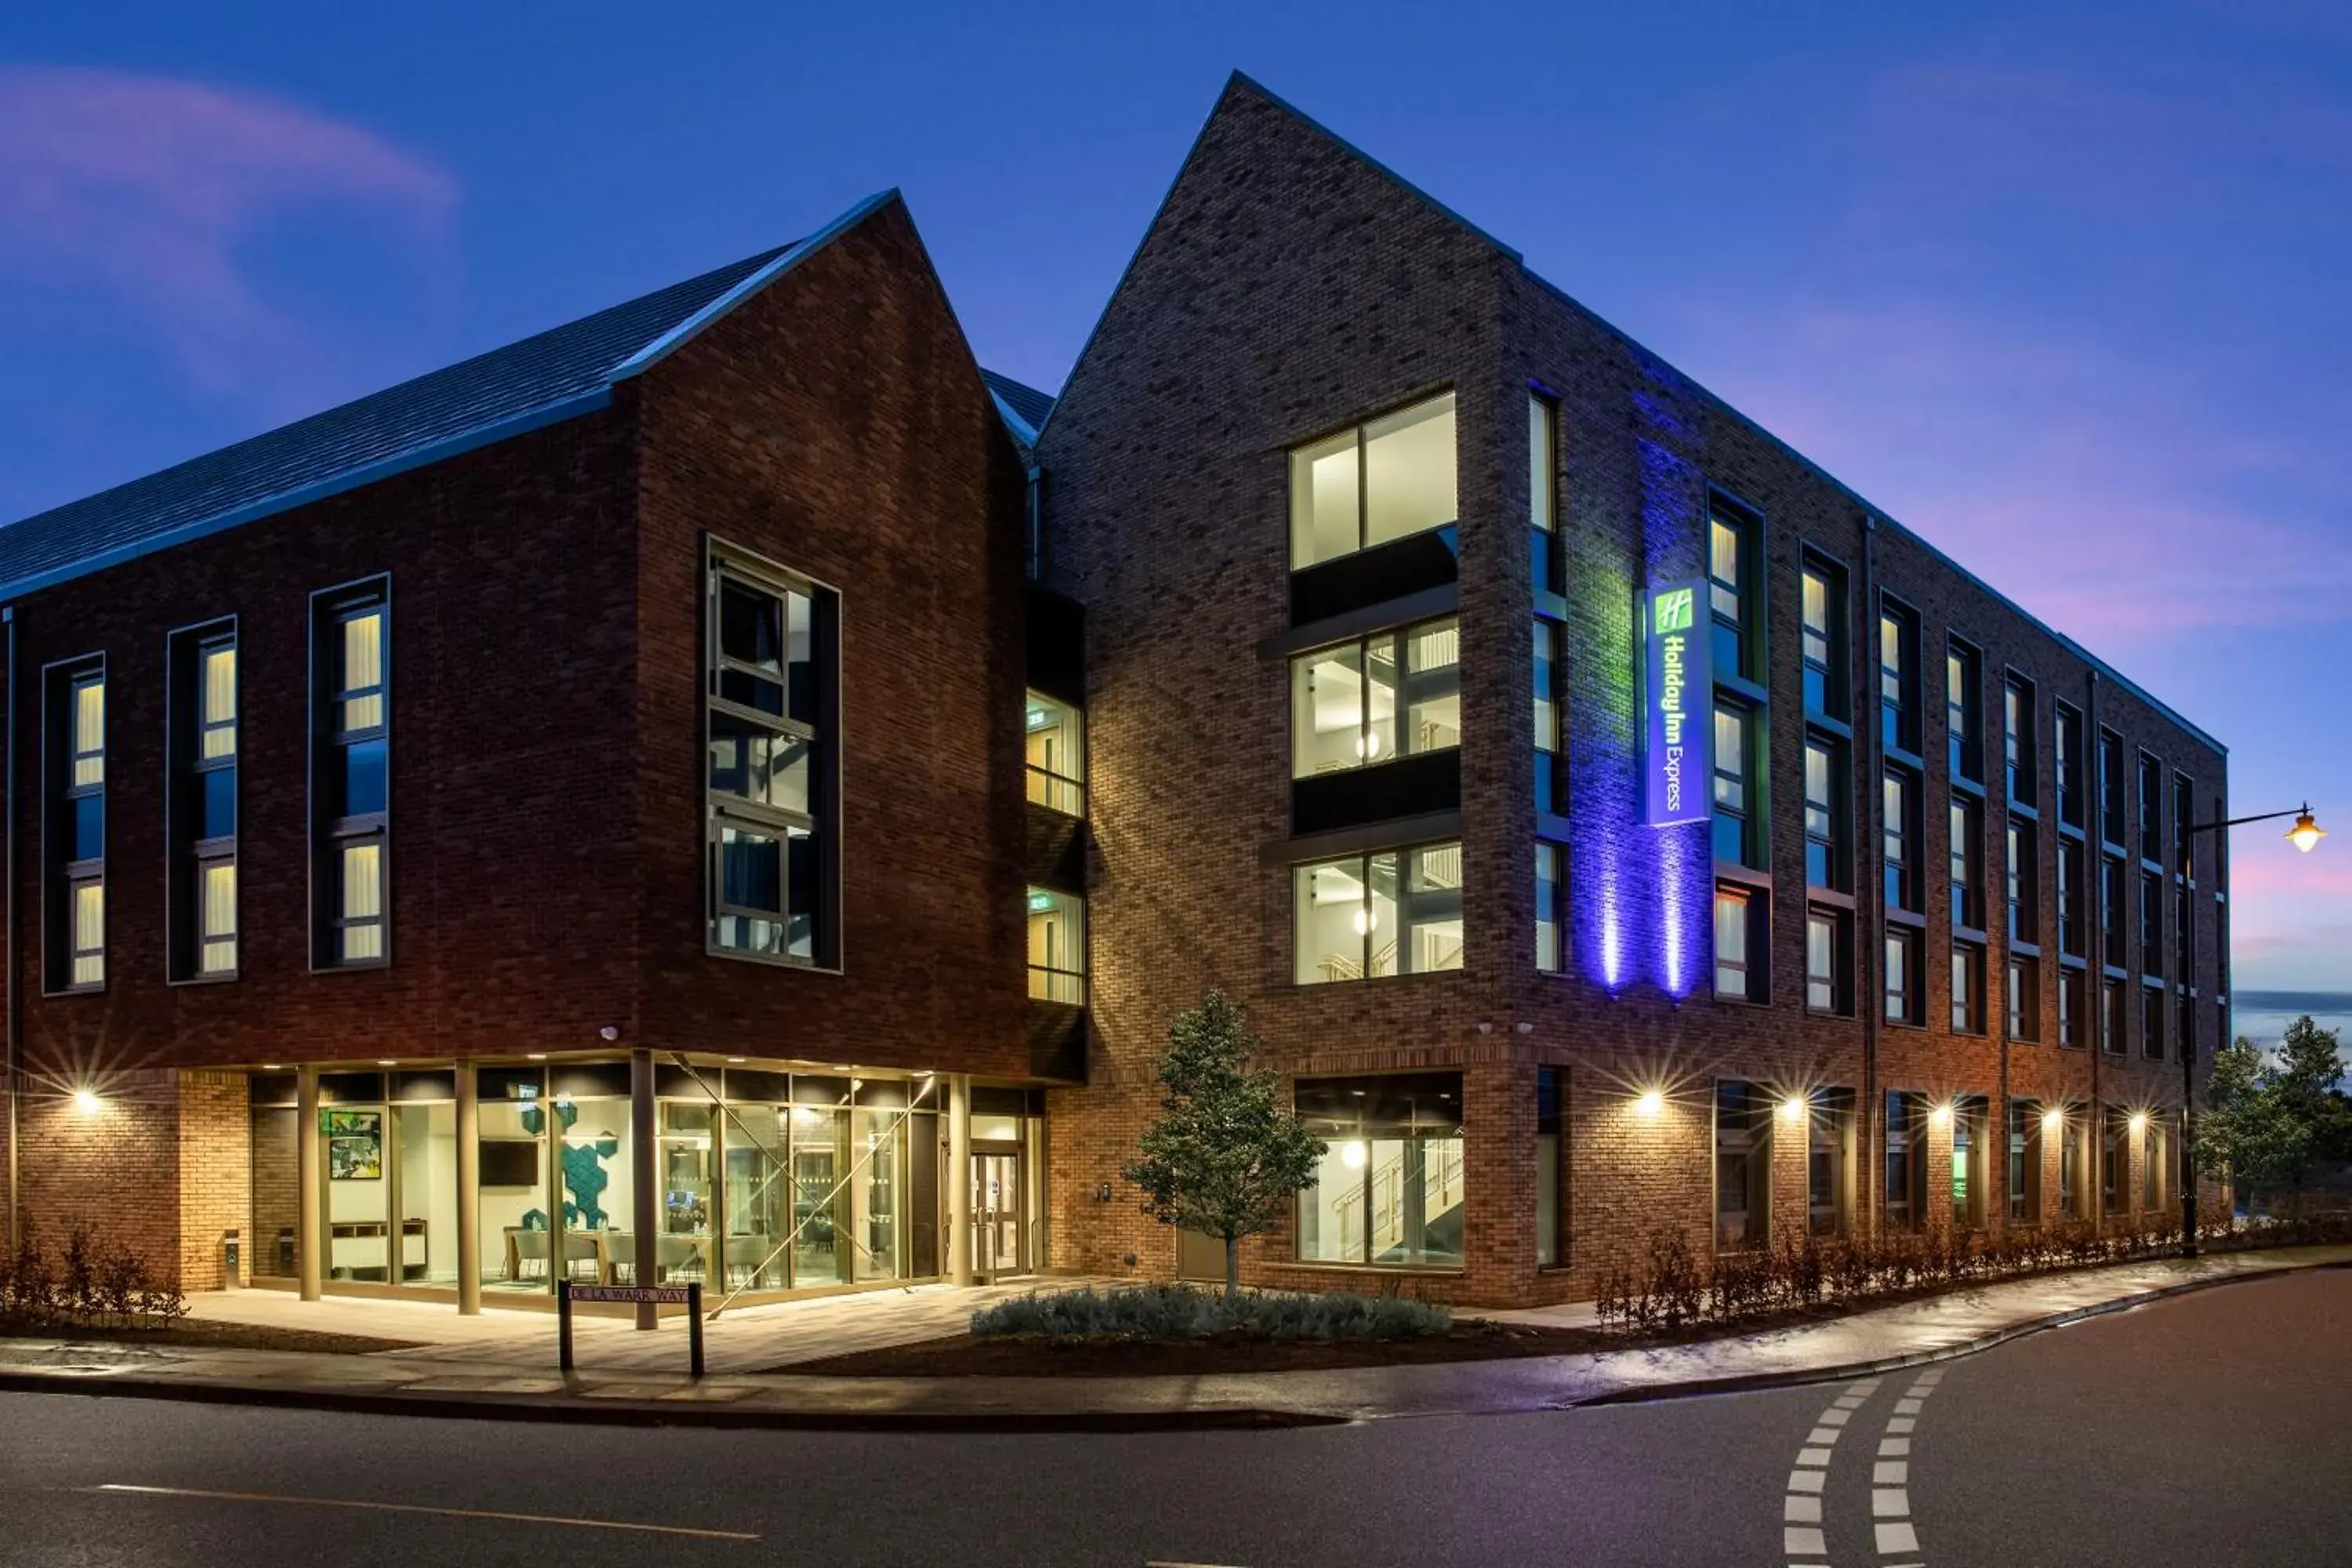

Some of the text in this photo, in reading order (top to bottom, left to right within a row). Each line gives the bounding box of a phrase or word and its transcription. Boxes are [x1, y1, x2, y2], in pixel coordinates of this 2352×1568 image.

[1661, 636, 1686, 811] Holiday Inn Express
[592, 1288, 608, 1300] LA
[612, 1288, 650, 1301] WARR
[657, 1289, 686, 1301] WAY
